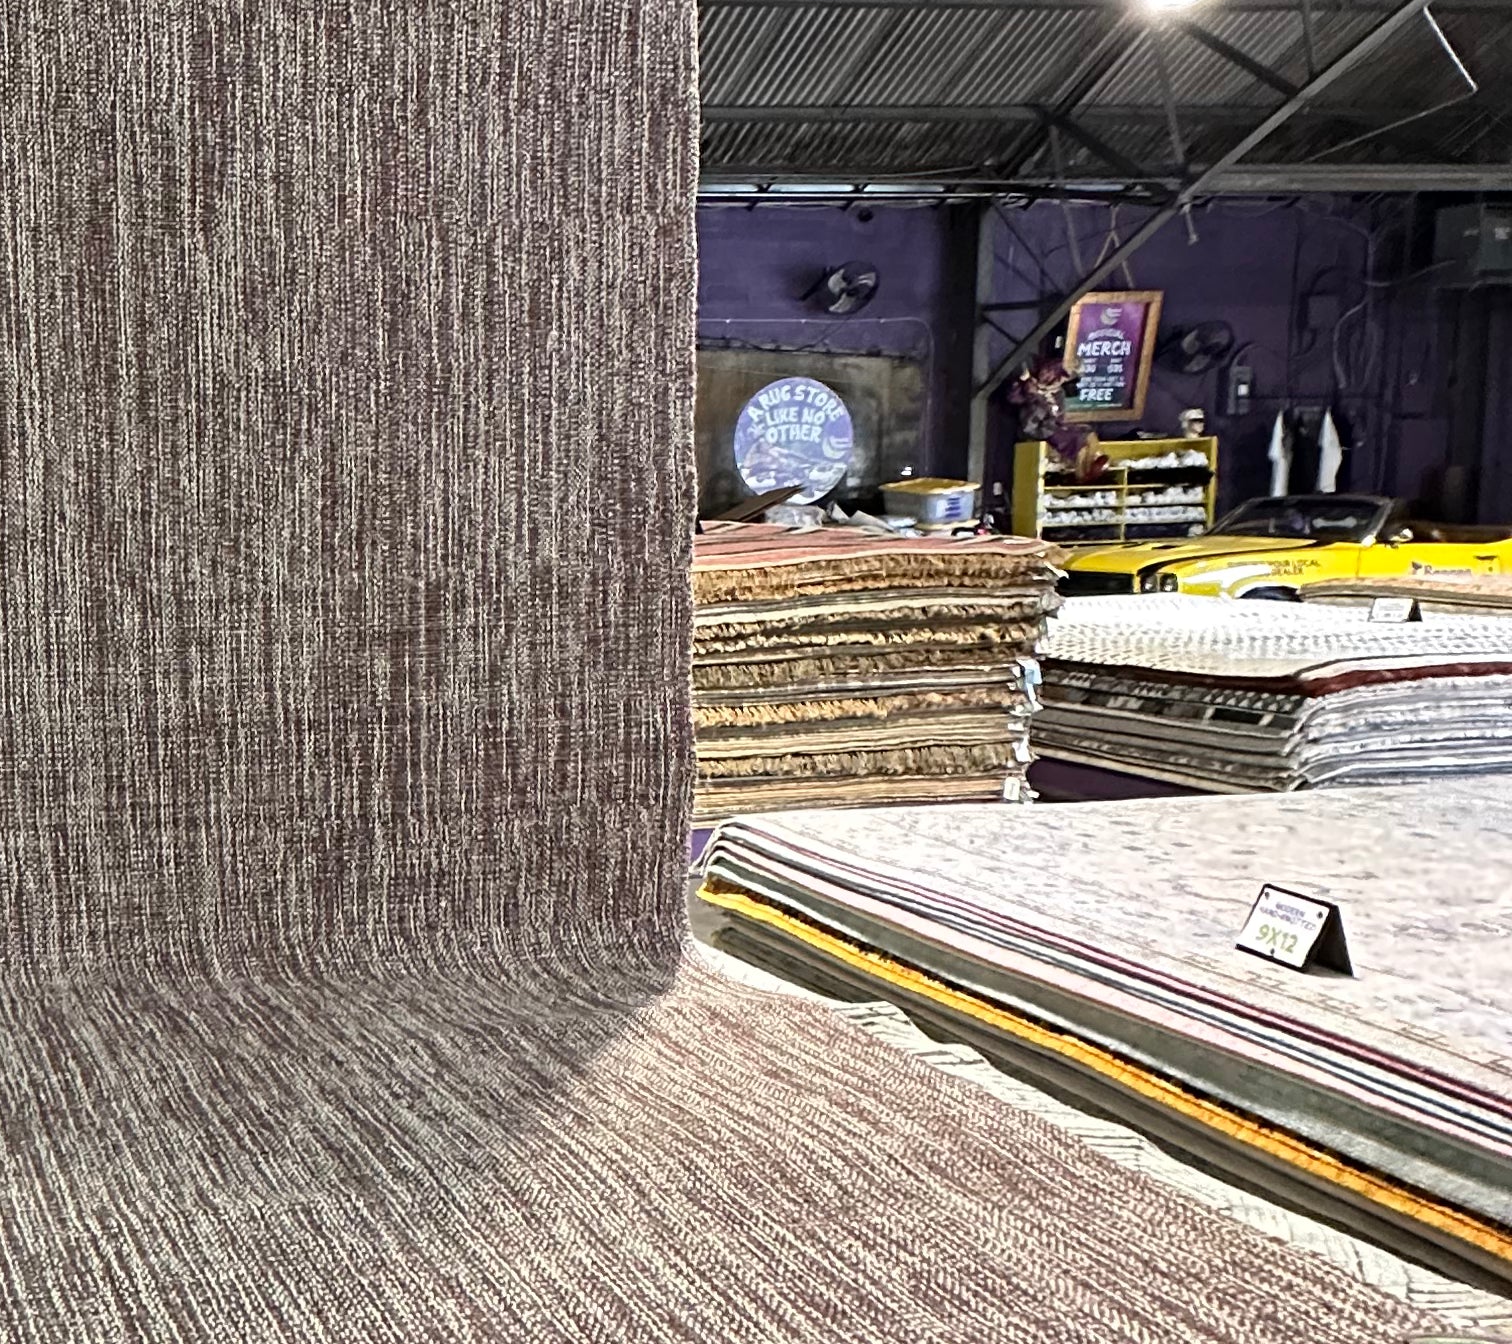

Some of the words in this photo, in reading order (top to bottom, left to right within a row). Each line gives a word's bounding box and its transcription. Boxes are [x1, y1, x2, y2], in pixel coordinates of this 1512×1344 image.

[1077, 340, 1132, 356] MERCH
[747, 406, 764, 423] A
[758, 385, 791, 411] RUG
[794, 385, 843, 421] STORE
[1079, 388, 1114, 401] FREE
[765, 406, 799, 426] LIKE
[801, 407, 826, 425] NO
[765, 423, 823, 444] OTHER
